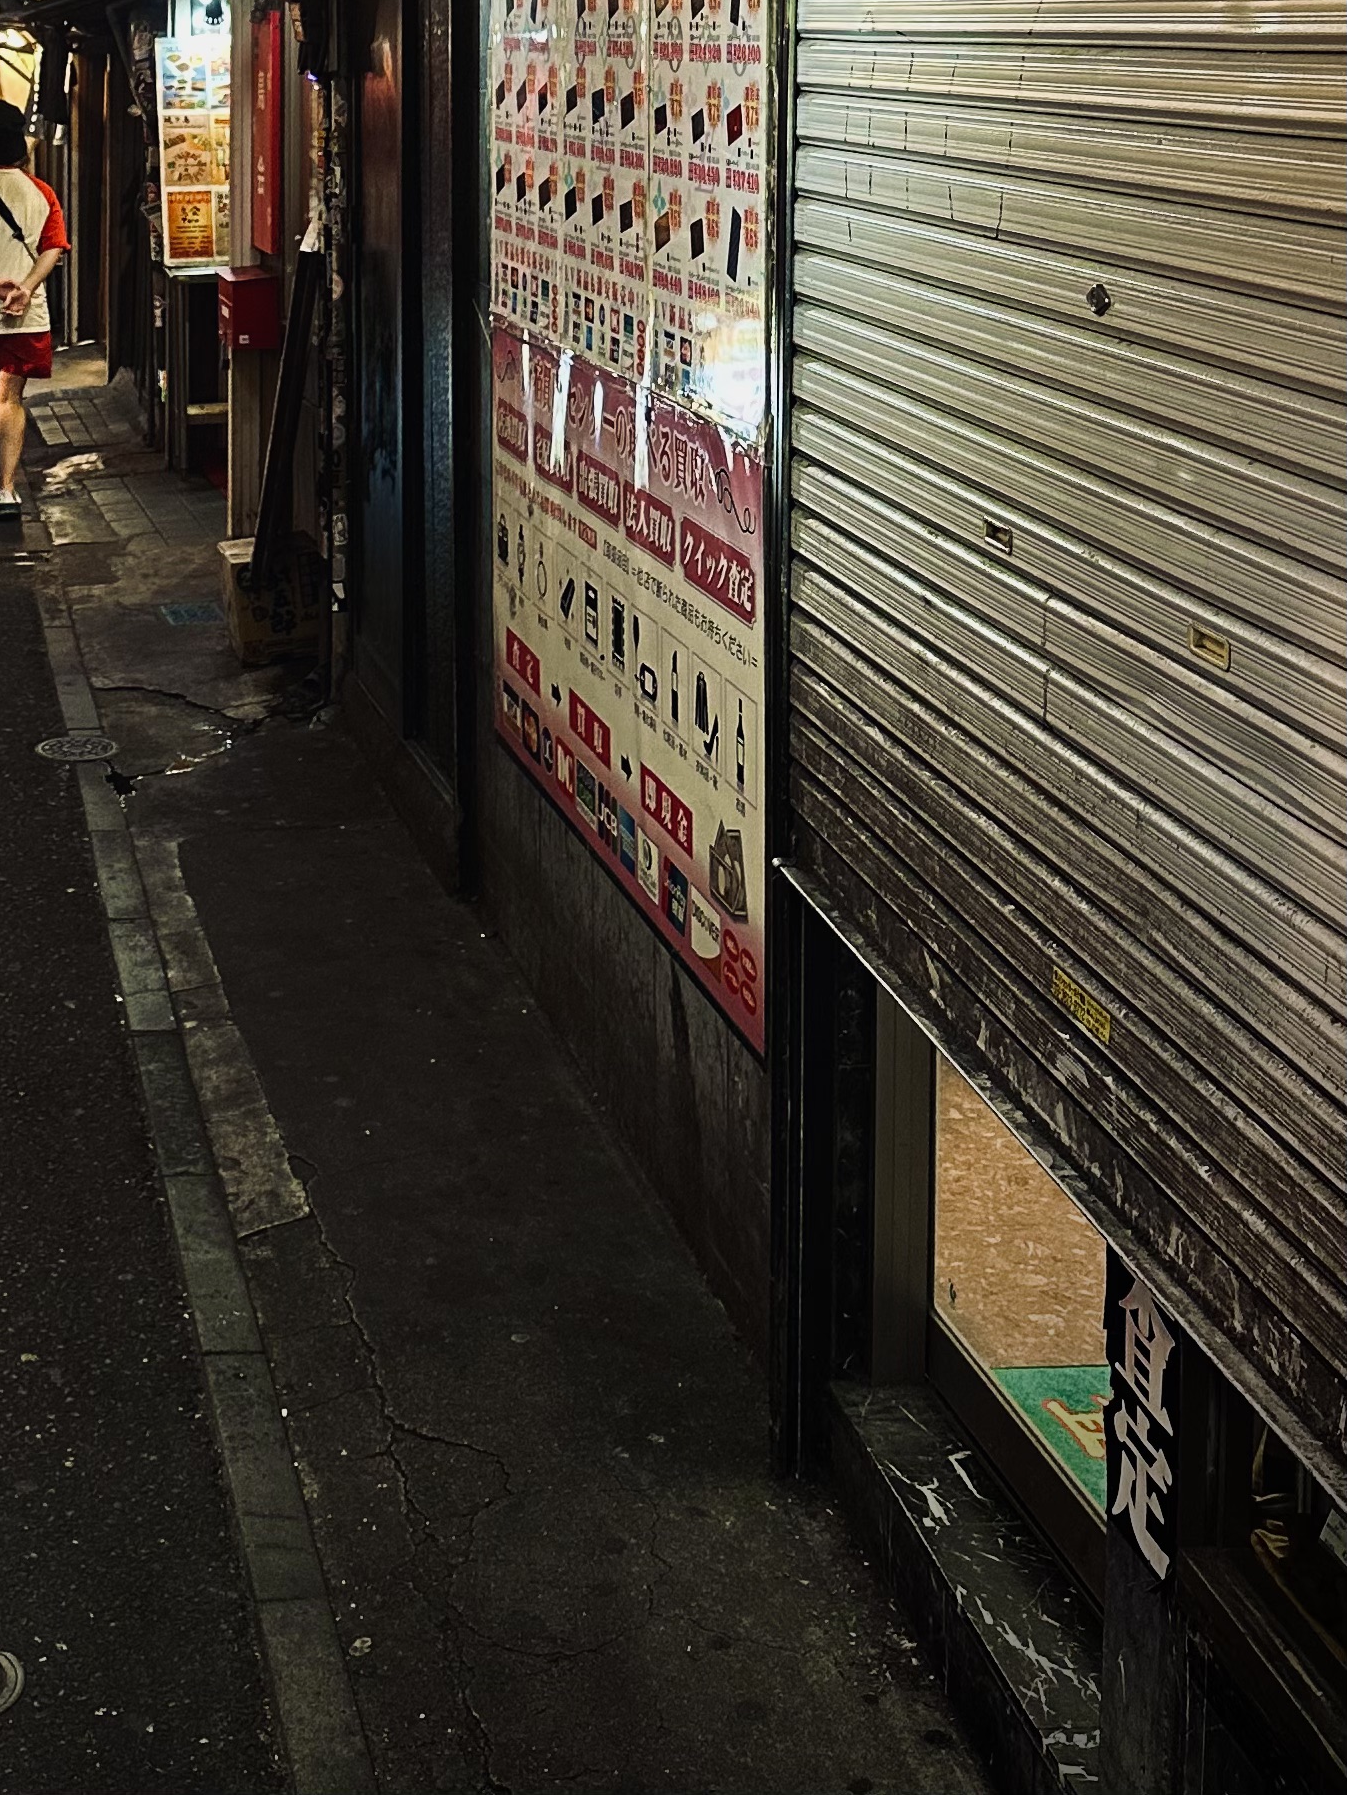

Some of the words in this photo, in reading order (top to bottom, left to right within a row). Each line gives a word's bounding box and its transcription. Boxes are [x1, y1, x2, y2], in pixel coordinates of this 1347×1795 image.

[626, 494, 672, 554] 法人買取
[684, 530, 752, 612] クイック査定
[598, 800, 618, 838] JCB
